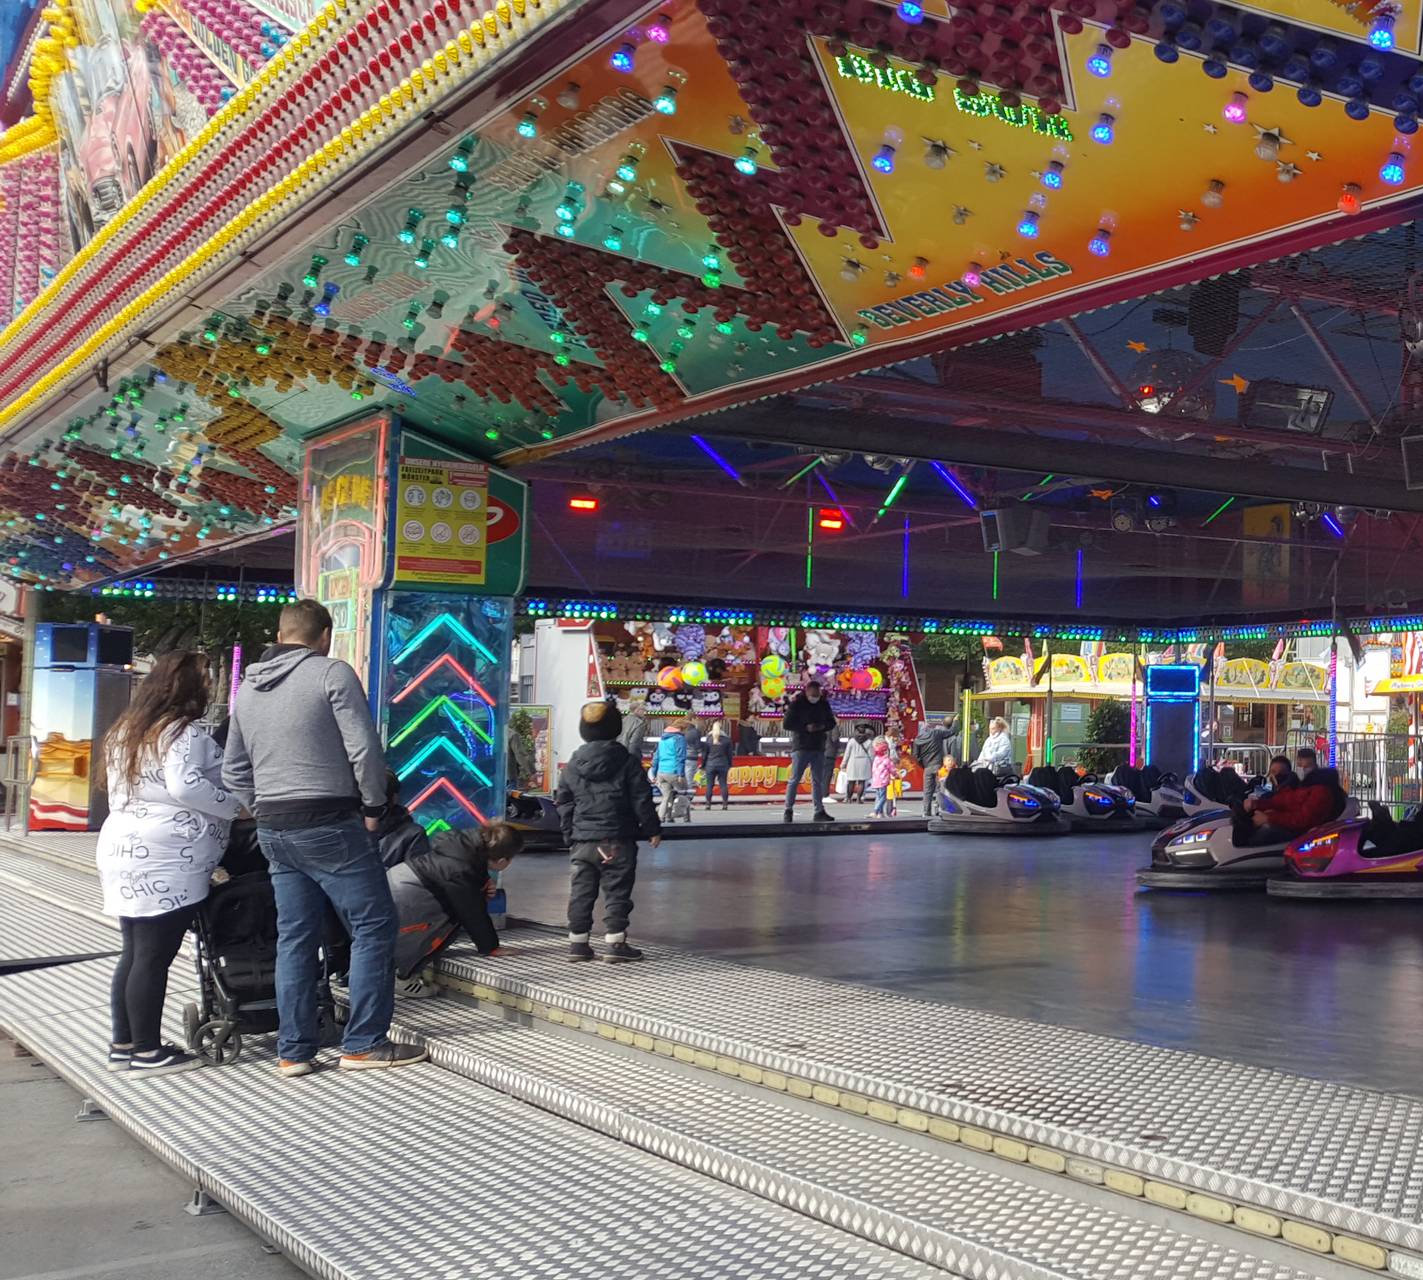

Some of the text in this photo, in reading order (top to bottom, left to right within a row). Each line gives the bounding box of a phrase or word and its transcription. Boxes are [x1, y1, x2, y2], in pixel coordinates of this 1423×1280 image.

[540, 86, 657, 159] BARBARA
[856, 250, 1073, 330] BEVERLY HILLS
[726, 764, 778, 789] appy
[119, 879, 170, 900] CHIC
